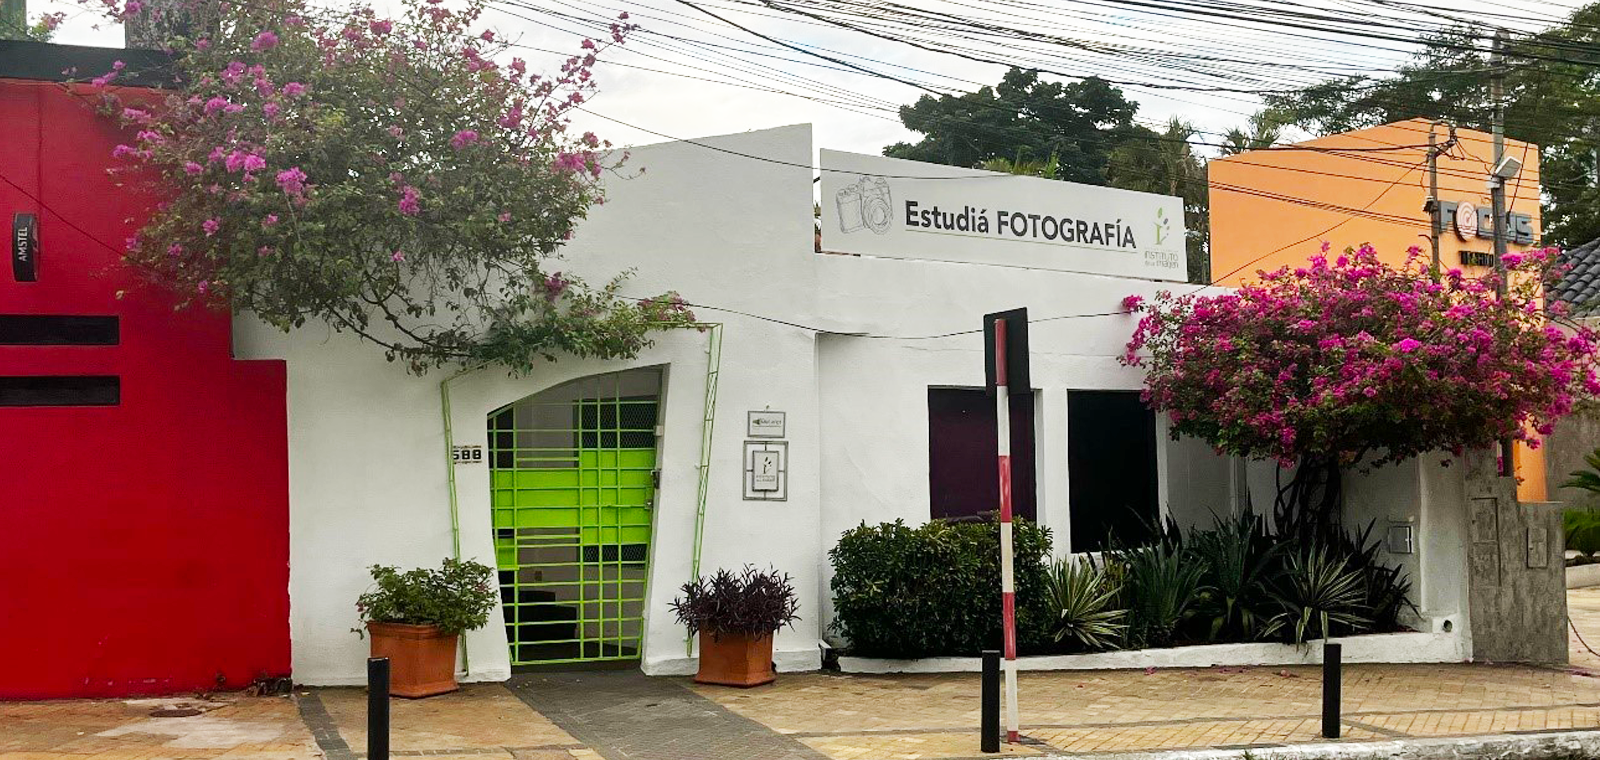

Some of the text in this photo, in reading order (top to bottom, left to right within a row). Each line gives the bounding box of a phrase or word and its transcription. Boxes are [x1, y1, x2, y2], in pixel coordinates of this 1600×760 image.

[904, 199, 1137, 249] Estudiá FOTOGRAFÍA
[17, 226, 28, 262] AMSTEL
[452, 448, 482, 460] 588
